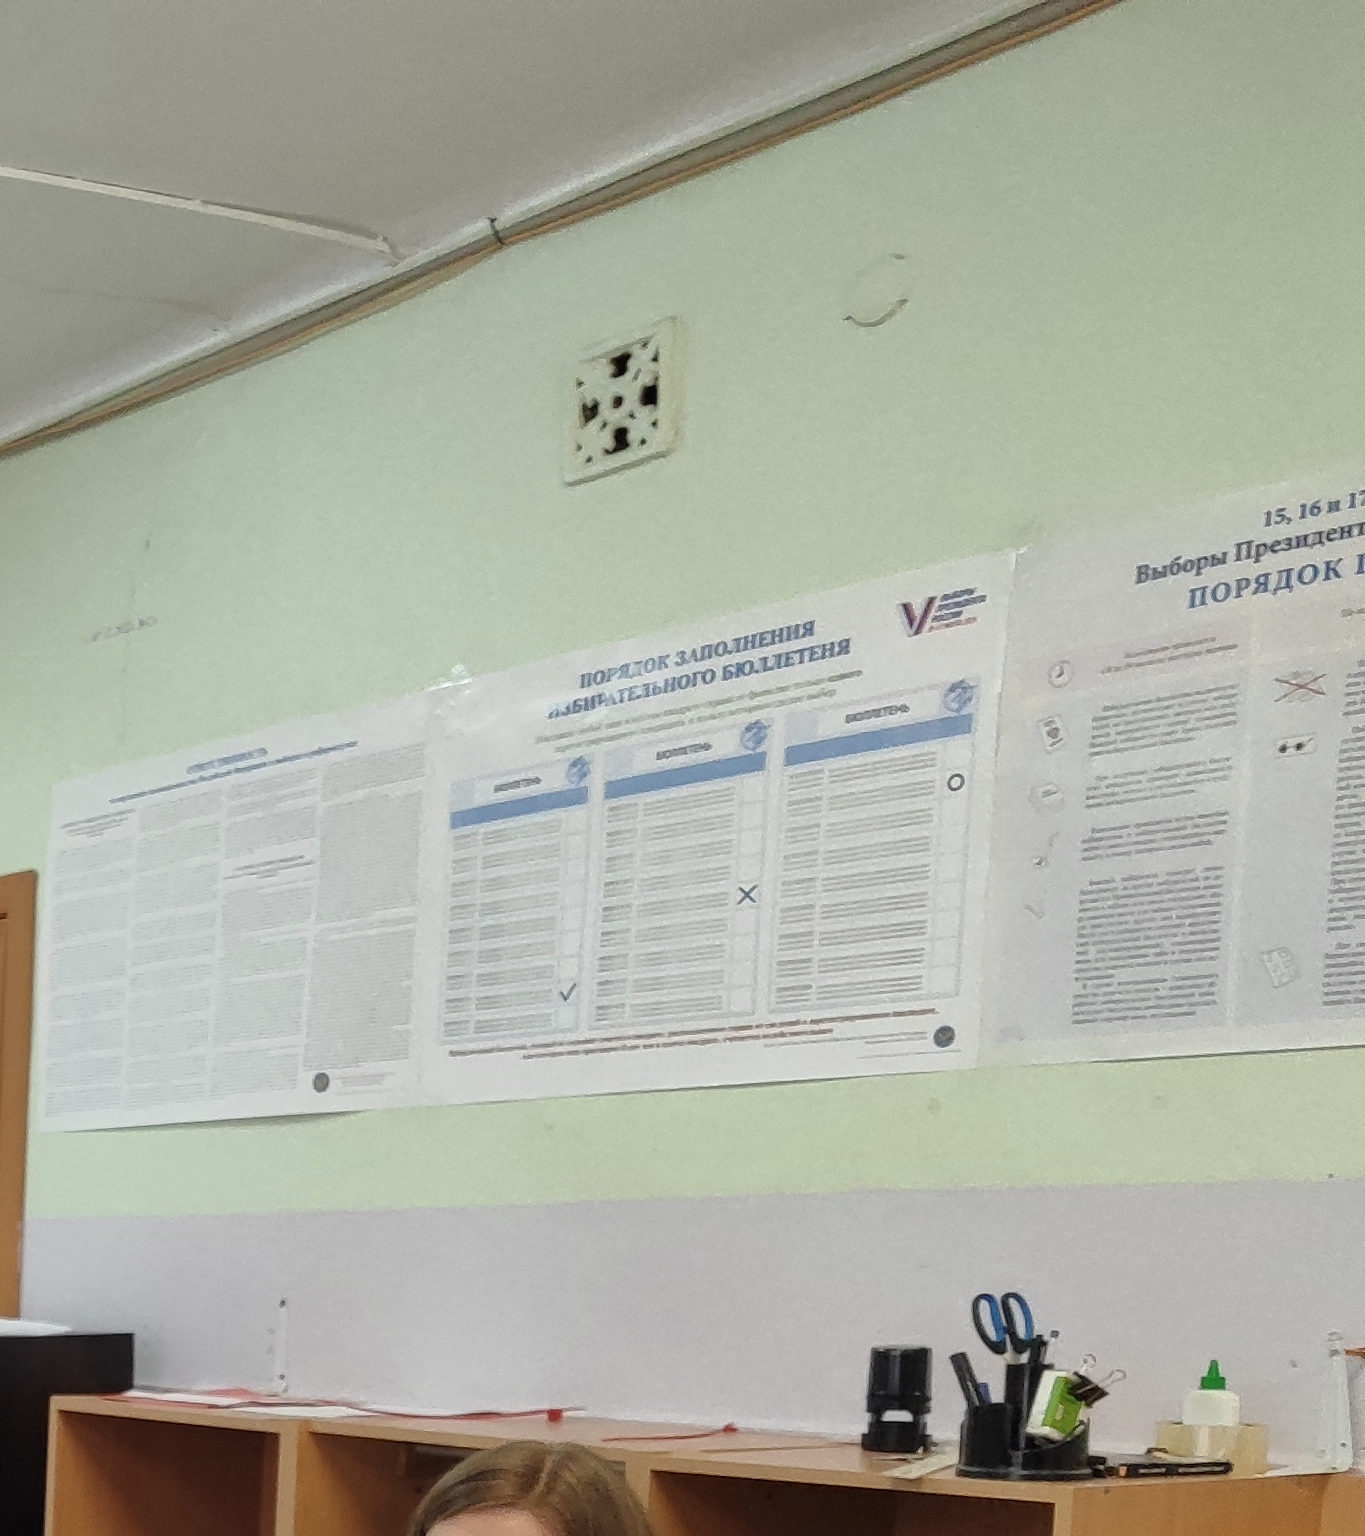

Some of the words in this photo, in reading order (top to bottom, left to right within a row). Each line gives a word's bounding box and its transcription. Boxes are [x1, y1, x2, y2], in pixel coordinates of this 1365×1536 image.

[1263, 507, 1293, 527] 15,
[1299, 499, 1322, 520] 16
[1326, 499, 1340, 515] и
[1135, 550, 1228, 585] Выборы
[1186, 557, 1344, 609] ПОРЯДОК
[579, 654, 671, 689] ПОРЯДОК
[674, 620, 816, 667] ЗАПОЛНЕНИЯ
[721, 637, 852, 682] БЮЛЛЕТЕНЯ
